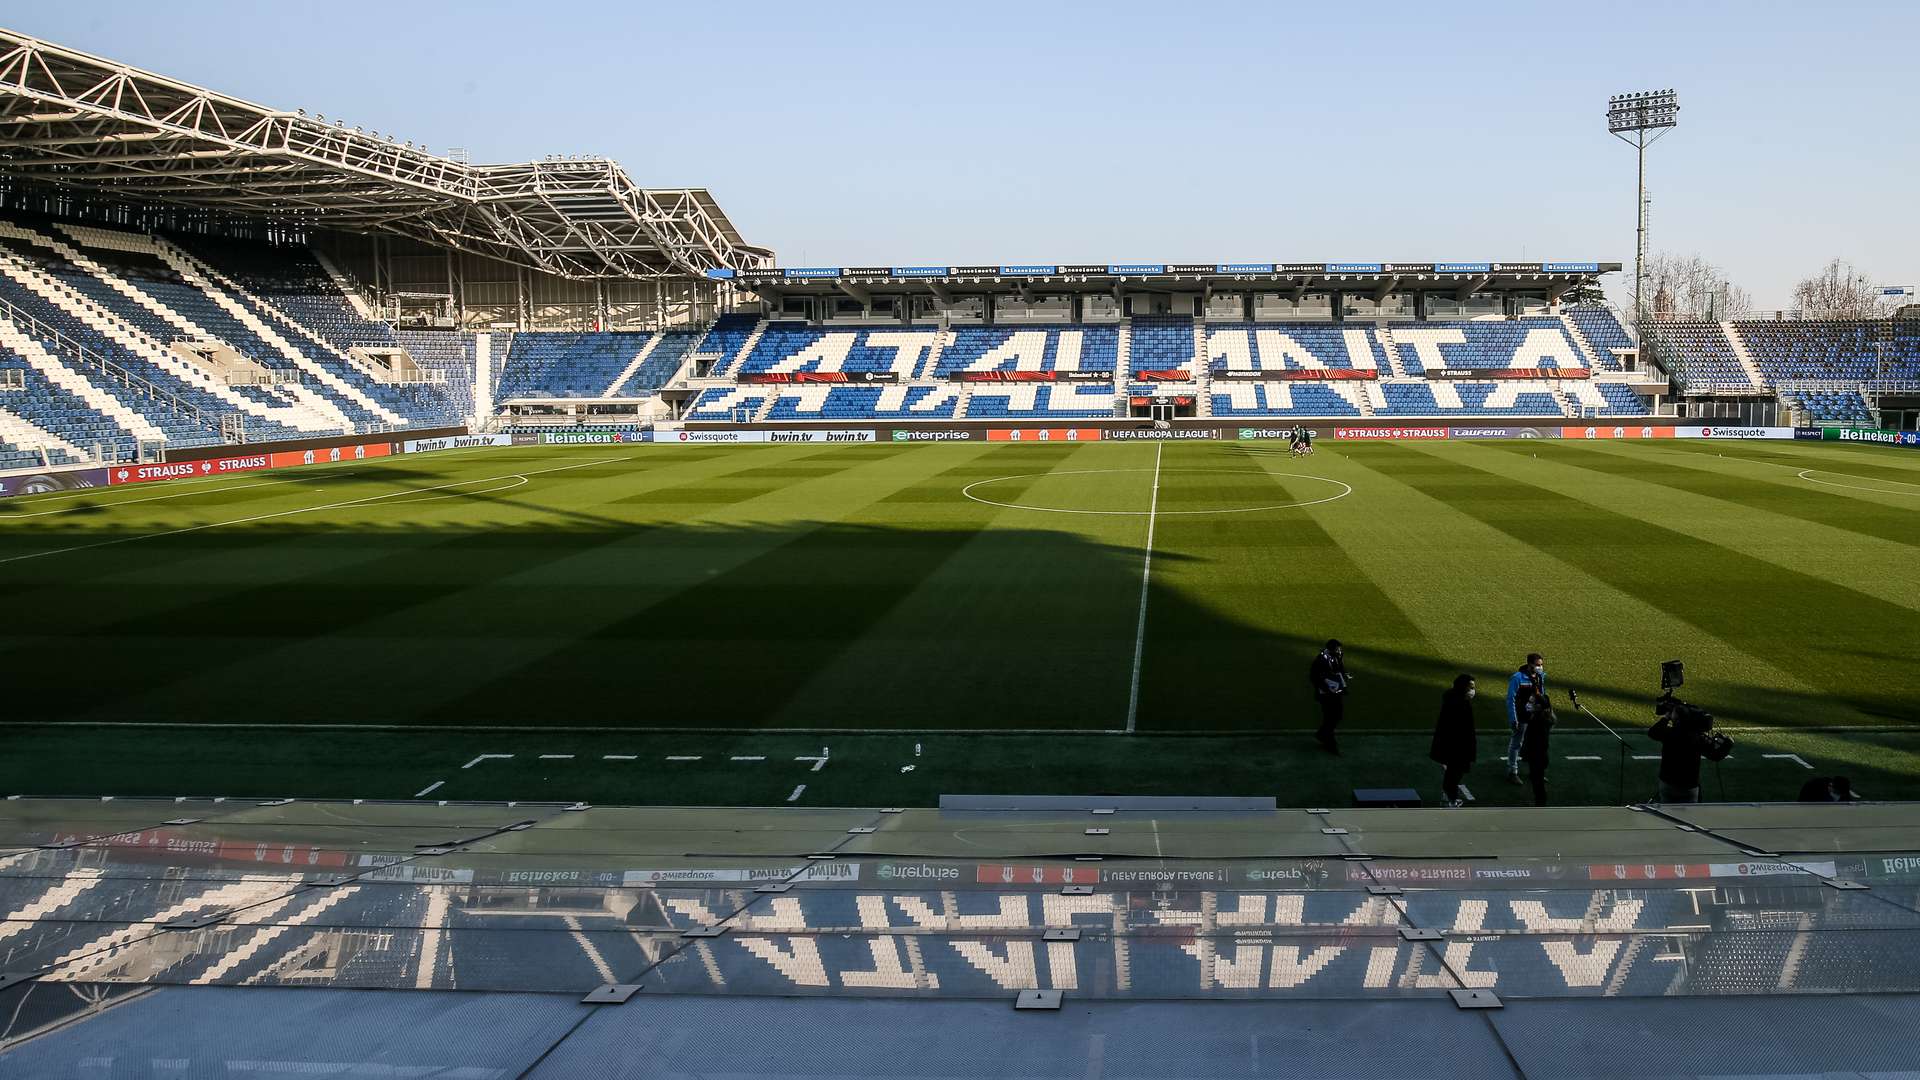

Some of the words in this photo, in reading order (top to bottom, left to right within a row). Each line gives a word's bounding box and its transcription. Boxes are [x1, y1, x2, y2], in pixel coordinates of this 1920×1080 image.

[545, 433, 611, 443] Heineken
[689, 432, 738, 442] Swissquote
[771, 431, 813, 442] bwin.tv
[826, 431, 869, 442] bwin.tv
[896, 431, 970, 441] enterprise
[1112, 430, 1136, 439] UEFA
[1138, 430, 1173, 439] EUROPA
[1174, 430, 1209, 439] LEAGUE
[1242, 429, 1317, 440] enterpe
[1348, 430, 1391, 438] STRAUSS
[1713, 428, 1765, 440] Swissquote
[1839, 429, 1894, 442] Heineken
[454, 435, 495, 447] bwin.tv
[219, 457, 266, 470] STRAUSS
[137, 464, 194, 479] STRAUSS
